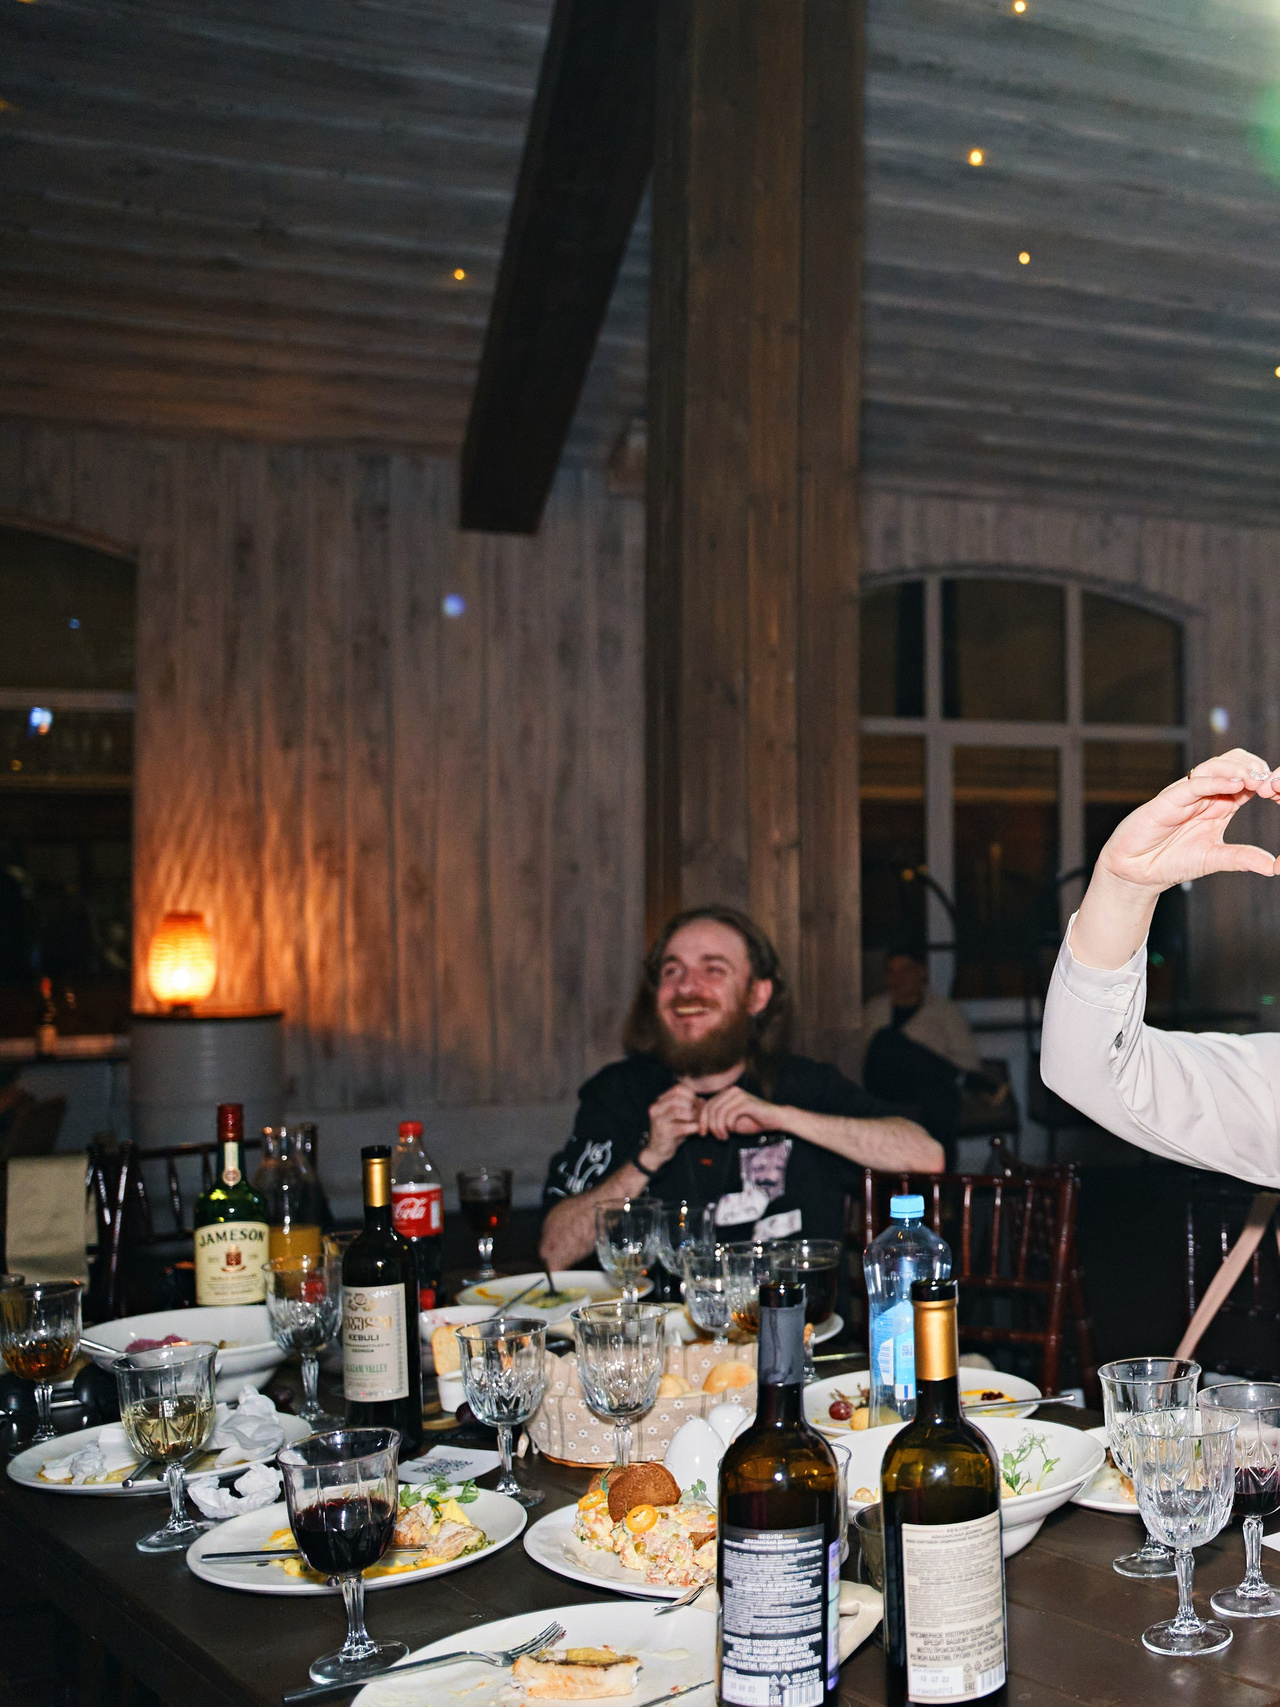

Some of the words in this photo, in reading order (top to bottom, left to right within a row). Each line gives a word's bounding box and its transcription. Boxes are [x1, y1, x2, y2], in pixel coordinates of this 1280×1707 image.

[199, 1228, 266, 1248] JAMESON
[348, 1334, 379, 1342] KEBULI
[365, 1363, 388, 1373] VALLEY
